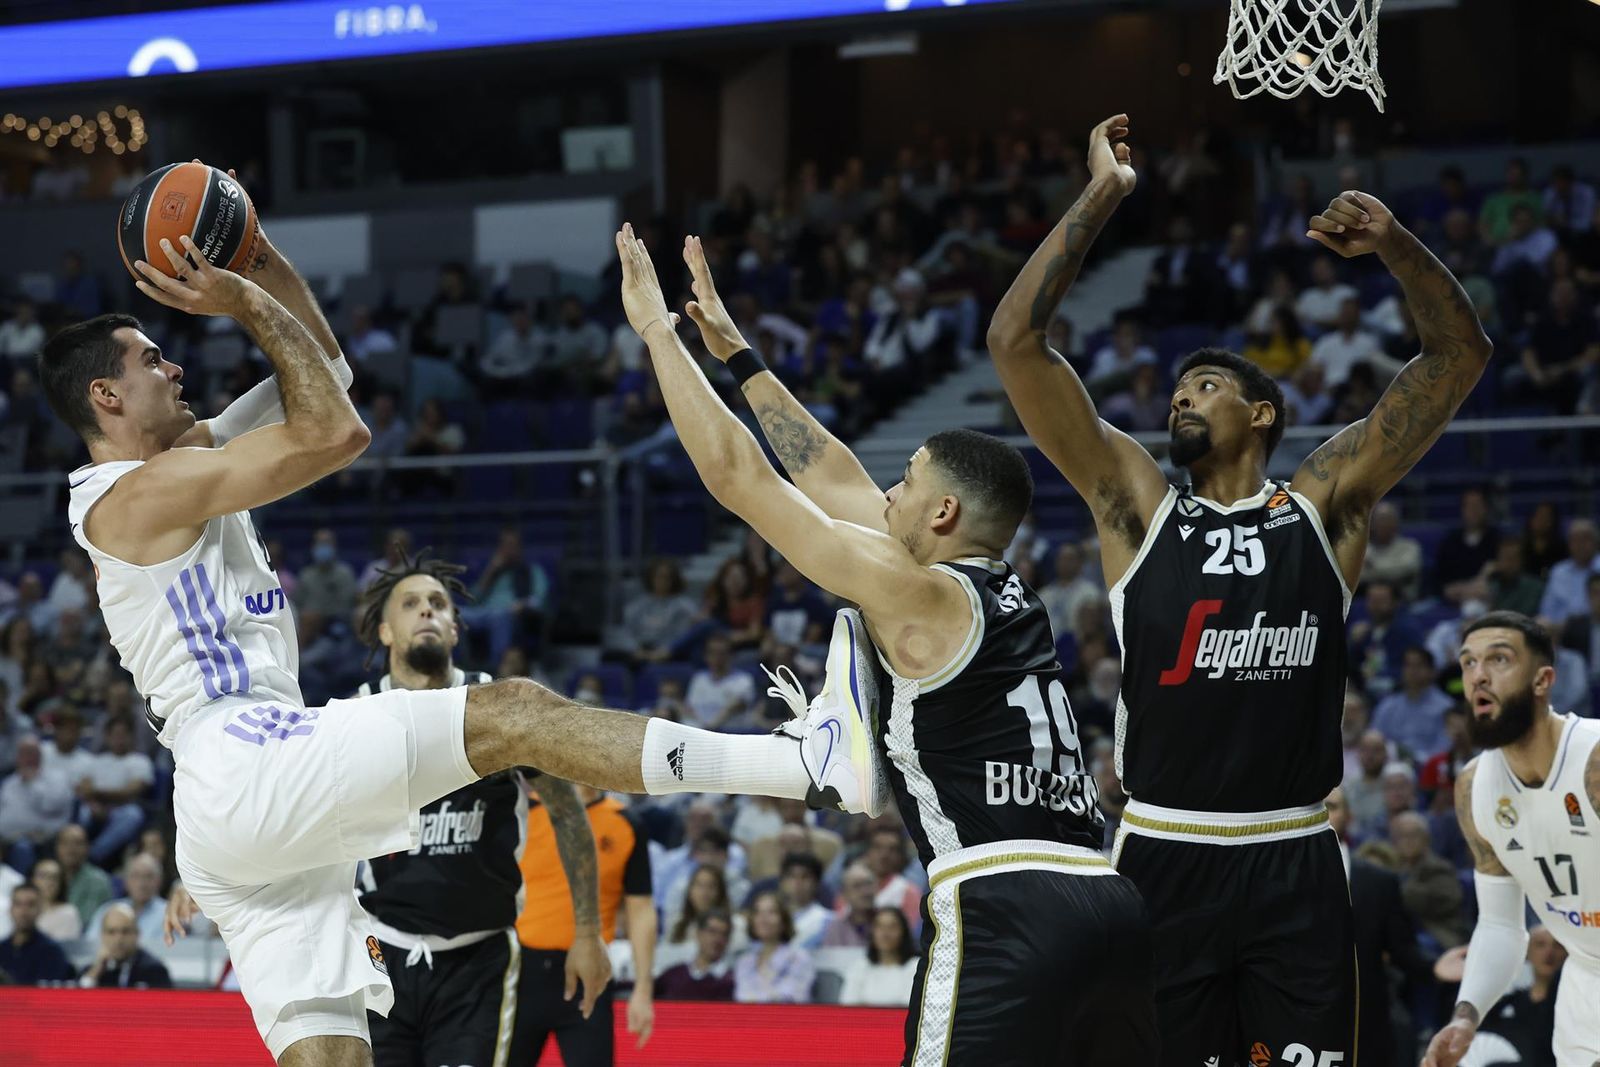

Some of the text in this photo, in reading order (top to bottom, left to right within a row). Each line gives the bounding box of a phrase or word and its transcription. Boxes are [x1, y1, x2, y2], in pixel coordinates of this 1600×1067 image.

[207, 201, 236, 265] TURKISH AIRLI
[1263, 513, 1301, 530] oneteam
[1202, 524, 1266, 576] 25
[1234, 669, 1292, 681] ZANETTI
[1006, 674, 1086, 776] 19
[677, 742, 686, 781] adidas
[1534, 853, 1578, 897] 17
